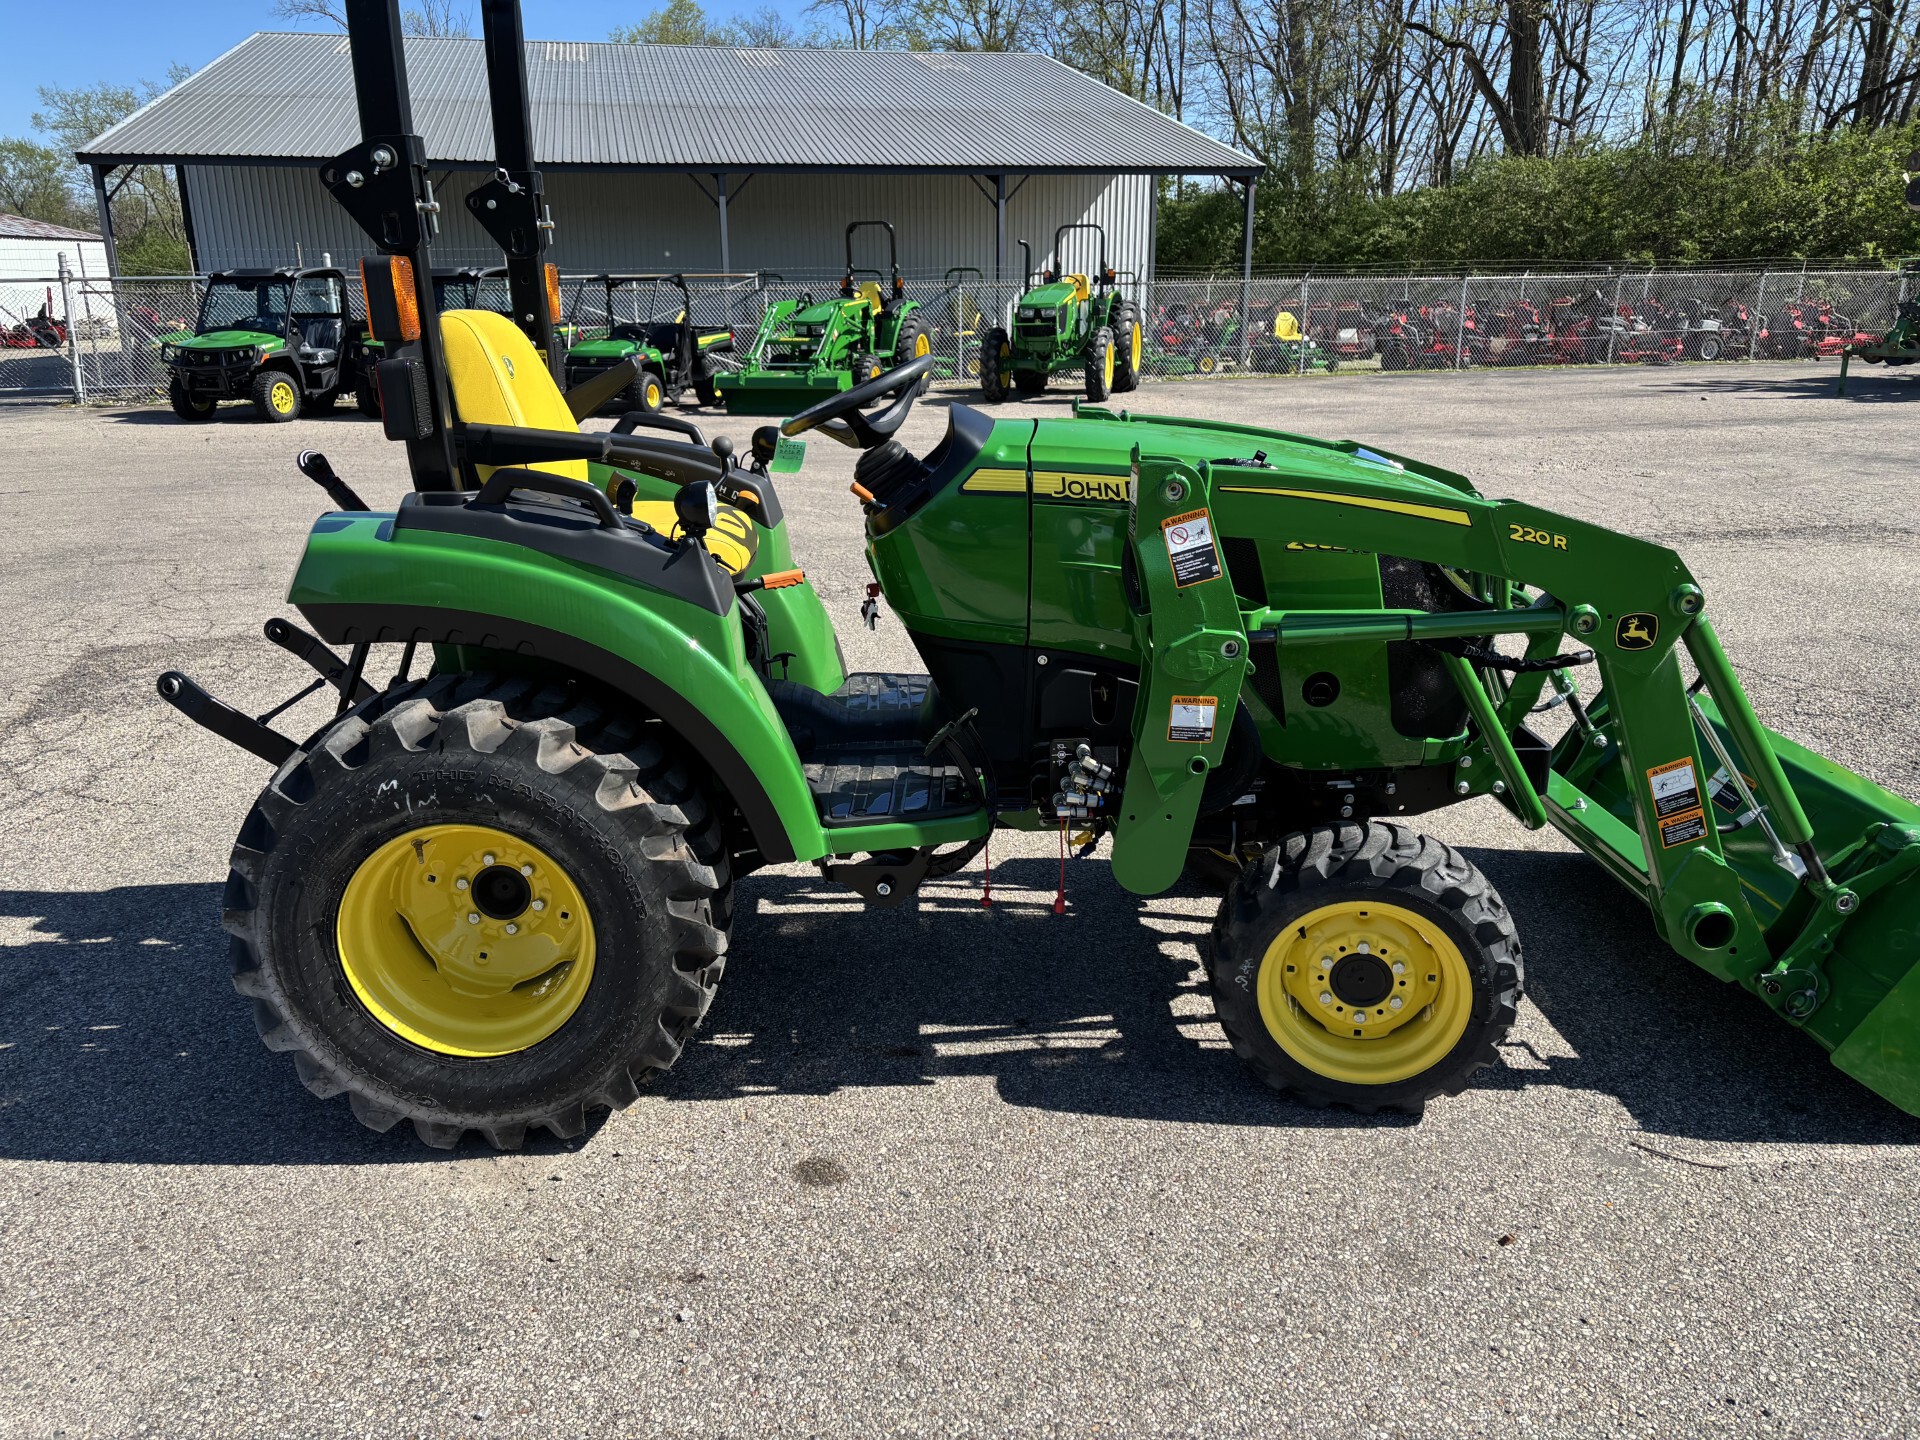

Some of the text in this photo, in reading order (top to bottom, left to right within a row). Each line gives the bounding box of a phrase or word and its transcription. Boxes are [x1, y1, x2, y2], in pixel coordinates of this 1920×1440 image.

[1054, 477, 1120, 498] JOHN
[1171, 510, 1206, 524] WARNING
[1181, 697, 1215, 705] WARNING
[1658, 760, 1688, 773] WARNING
[1670, 811, 1700, 824] WARNING
